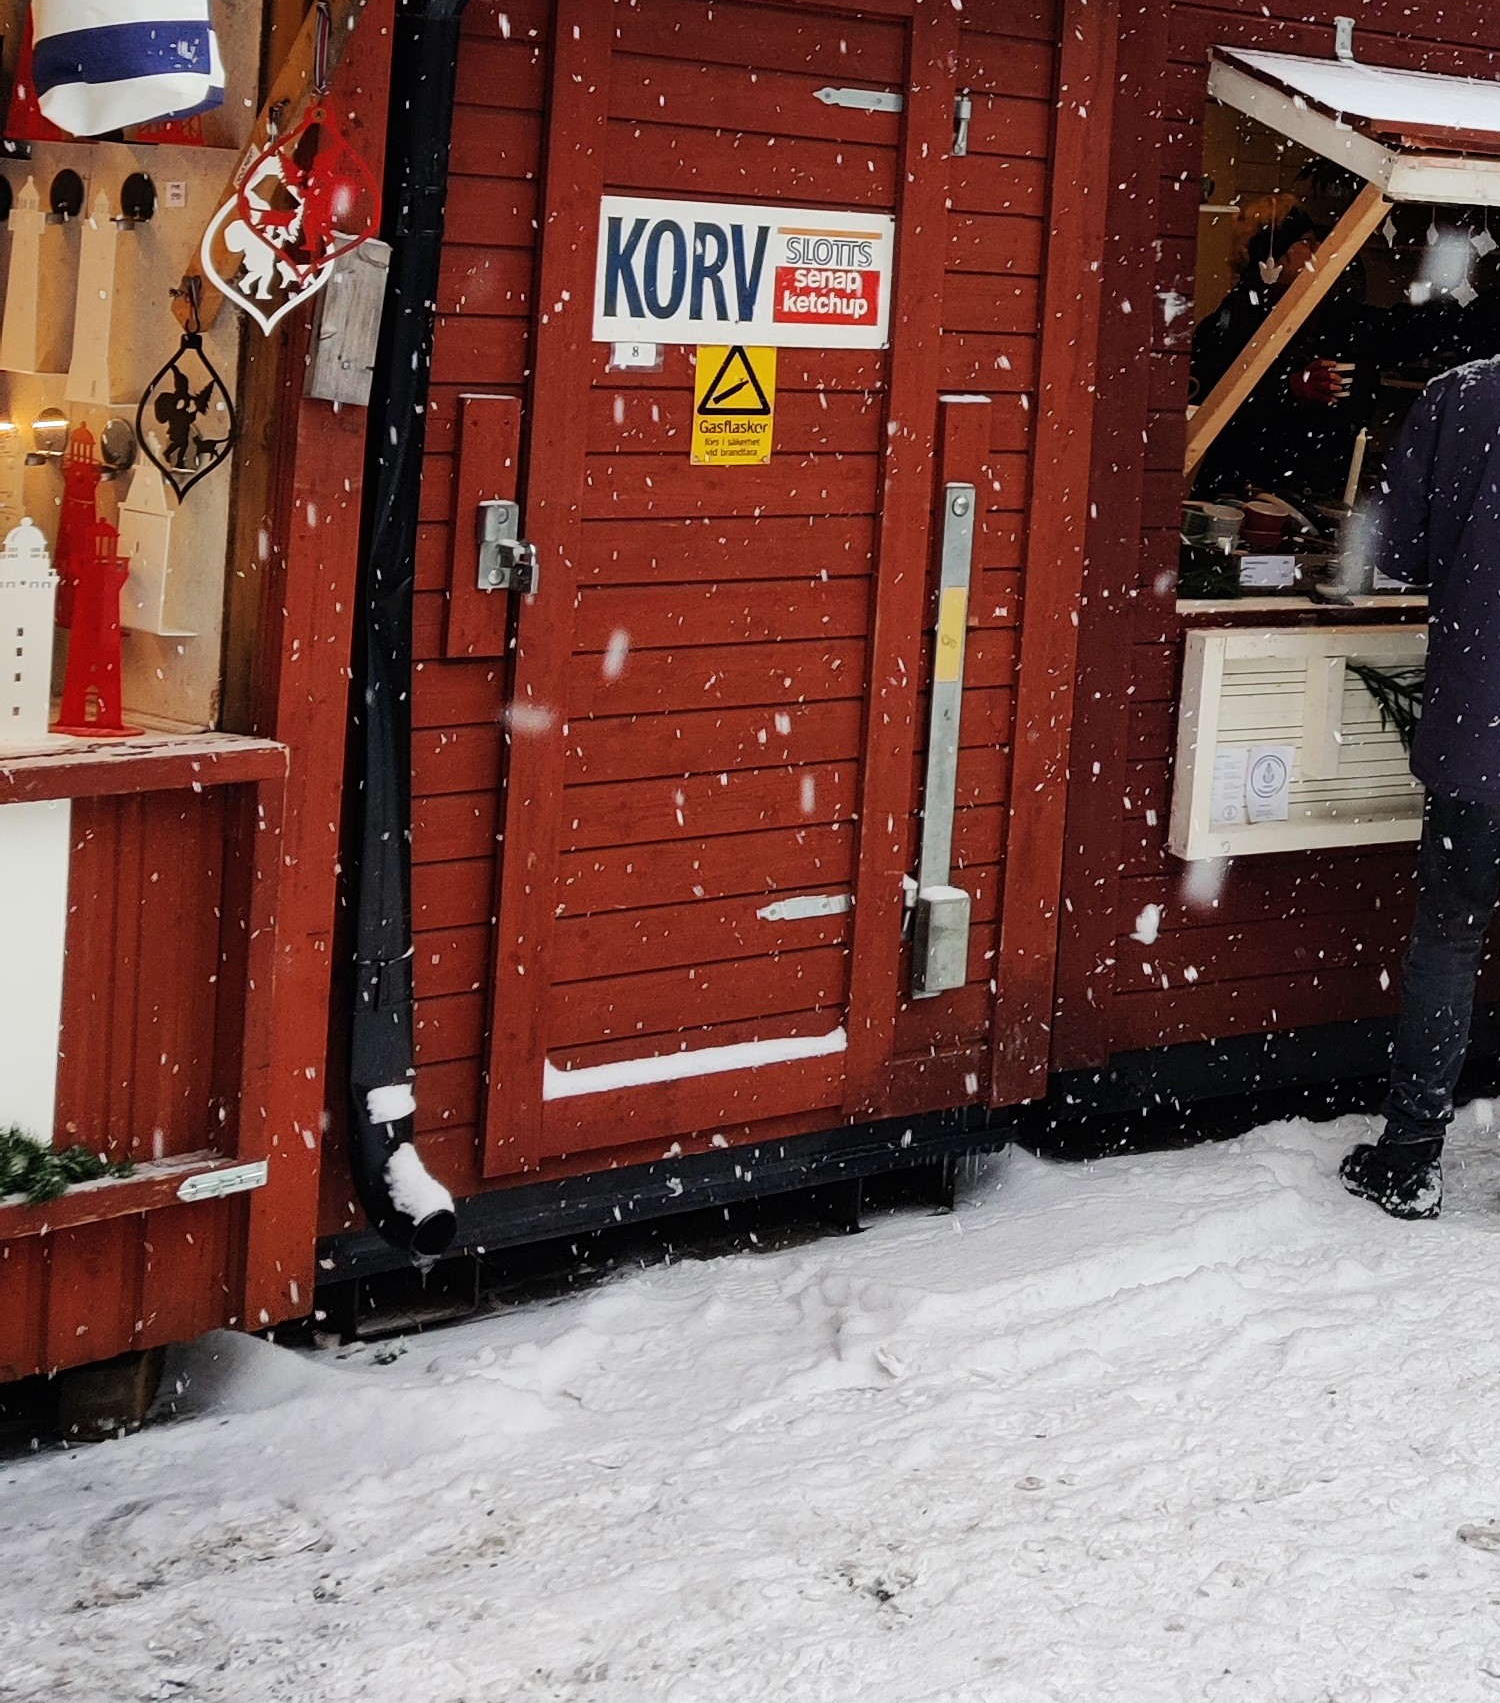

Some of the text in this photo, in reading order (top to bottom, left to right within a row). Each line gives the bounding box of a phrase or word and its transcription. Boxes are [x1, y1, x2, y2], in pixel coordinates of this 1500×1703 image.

[786, 236, 873, 268] SLOTTS
[603, 216, 771, 322] KORV
[793, 268, 863, 296] senap
[782, 289, 869, 319] ketchup
[632, 345, 640, 358] 8
[699, 419, 769, 434] Gasflaskor
